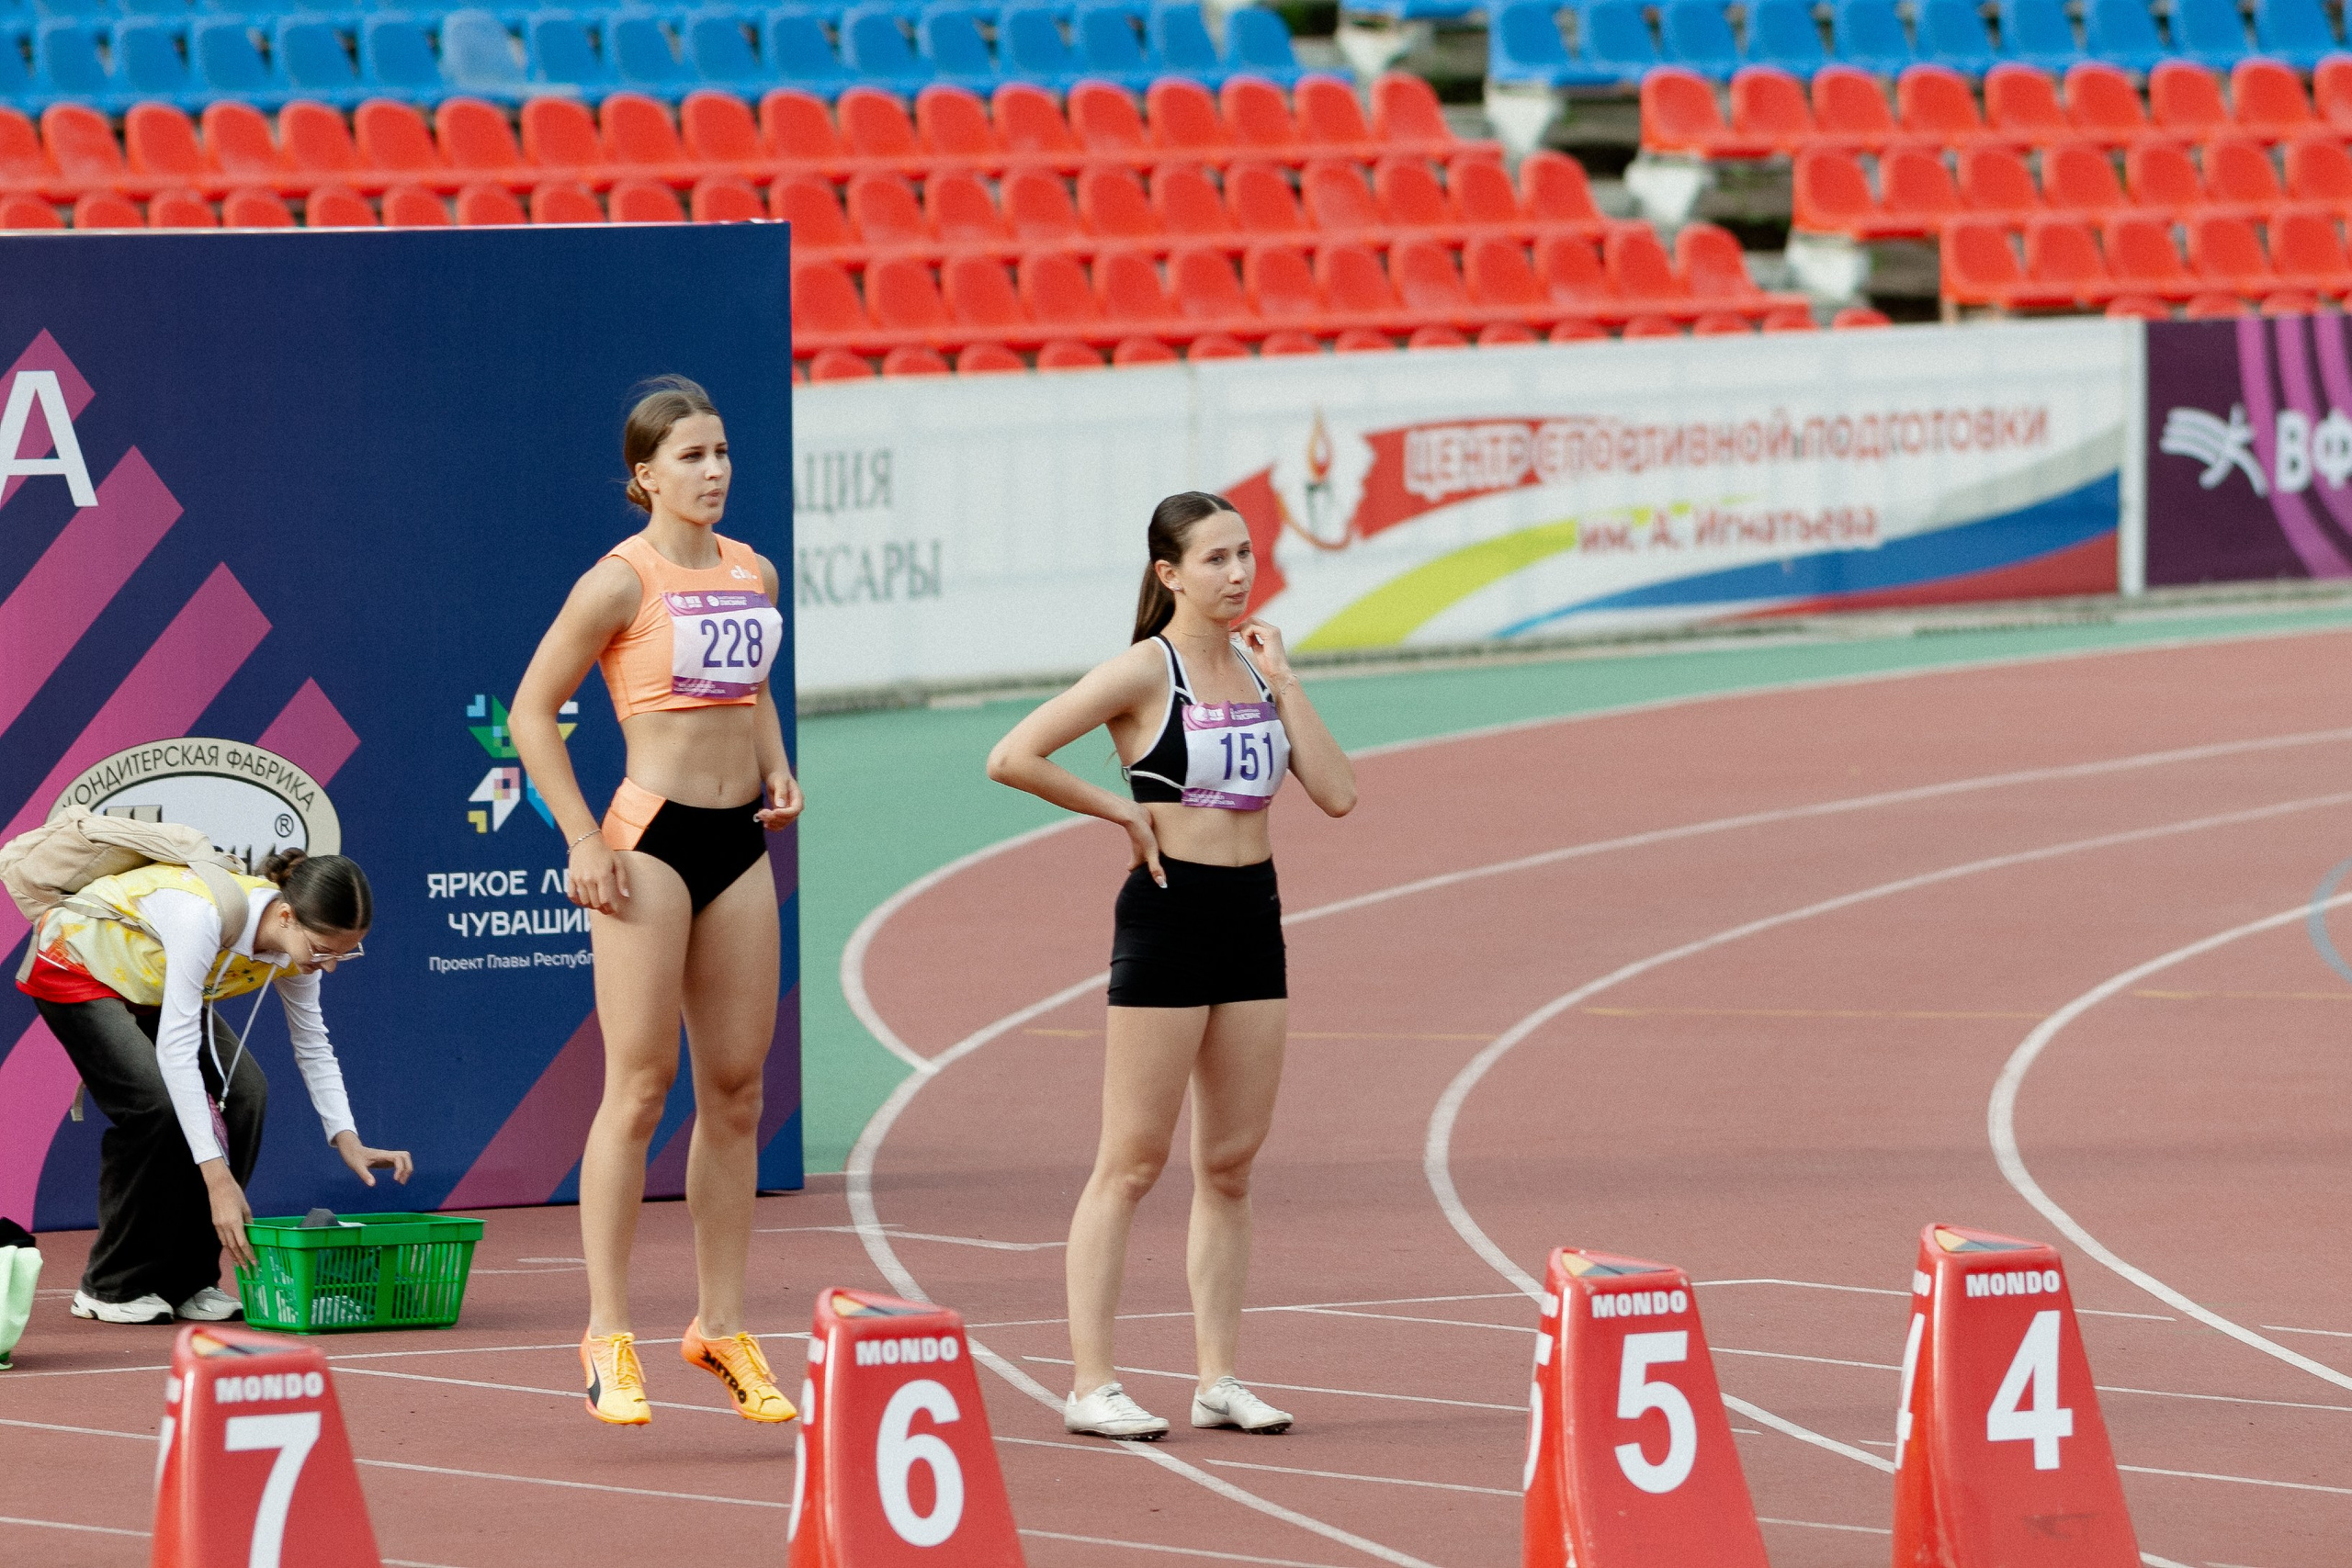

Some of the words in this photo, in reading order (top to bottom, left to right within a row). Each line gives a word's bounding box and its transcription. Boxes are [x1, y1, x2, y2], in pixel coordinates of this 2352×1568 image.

[1408, 426, 1532, 501] ЦЕНТР
[1537, 407, 1792, 481] СПОРТИВНОЙ
[1803, 404, 2049, 465] ПОДГОТОВКИ
[794, 450, 891, 516] ЦИЯ
[1693, 503, 1878, 547] Игнатьева
[700, 618, 763, 669] 228
[226, 748, 315, 812] ФАБРИКА
[1219, 732, 1274, 781] 151
[427, 870, 528, 898] ЯРКОЕ
[429, 955, 484, 974] Проект
[487, 953, 530, 969] Главы
[1591, 1290, 1688, 1318] MONDO
[1965, 1270, 2061, 1297] MONDO
[854, 1336, 959, 1366] MONDO
[214, 1371, 323, 1404] MONDO
[1614, 1330, 1698, 1495] 5
[1986, 1310, 2073, 1471] 4
[876, 1379, 964, 1548] 6
[224, 1412, 322, 1568] 7
